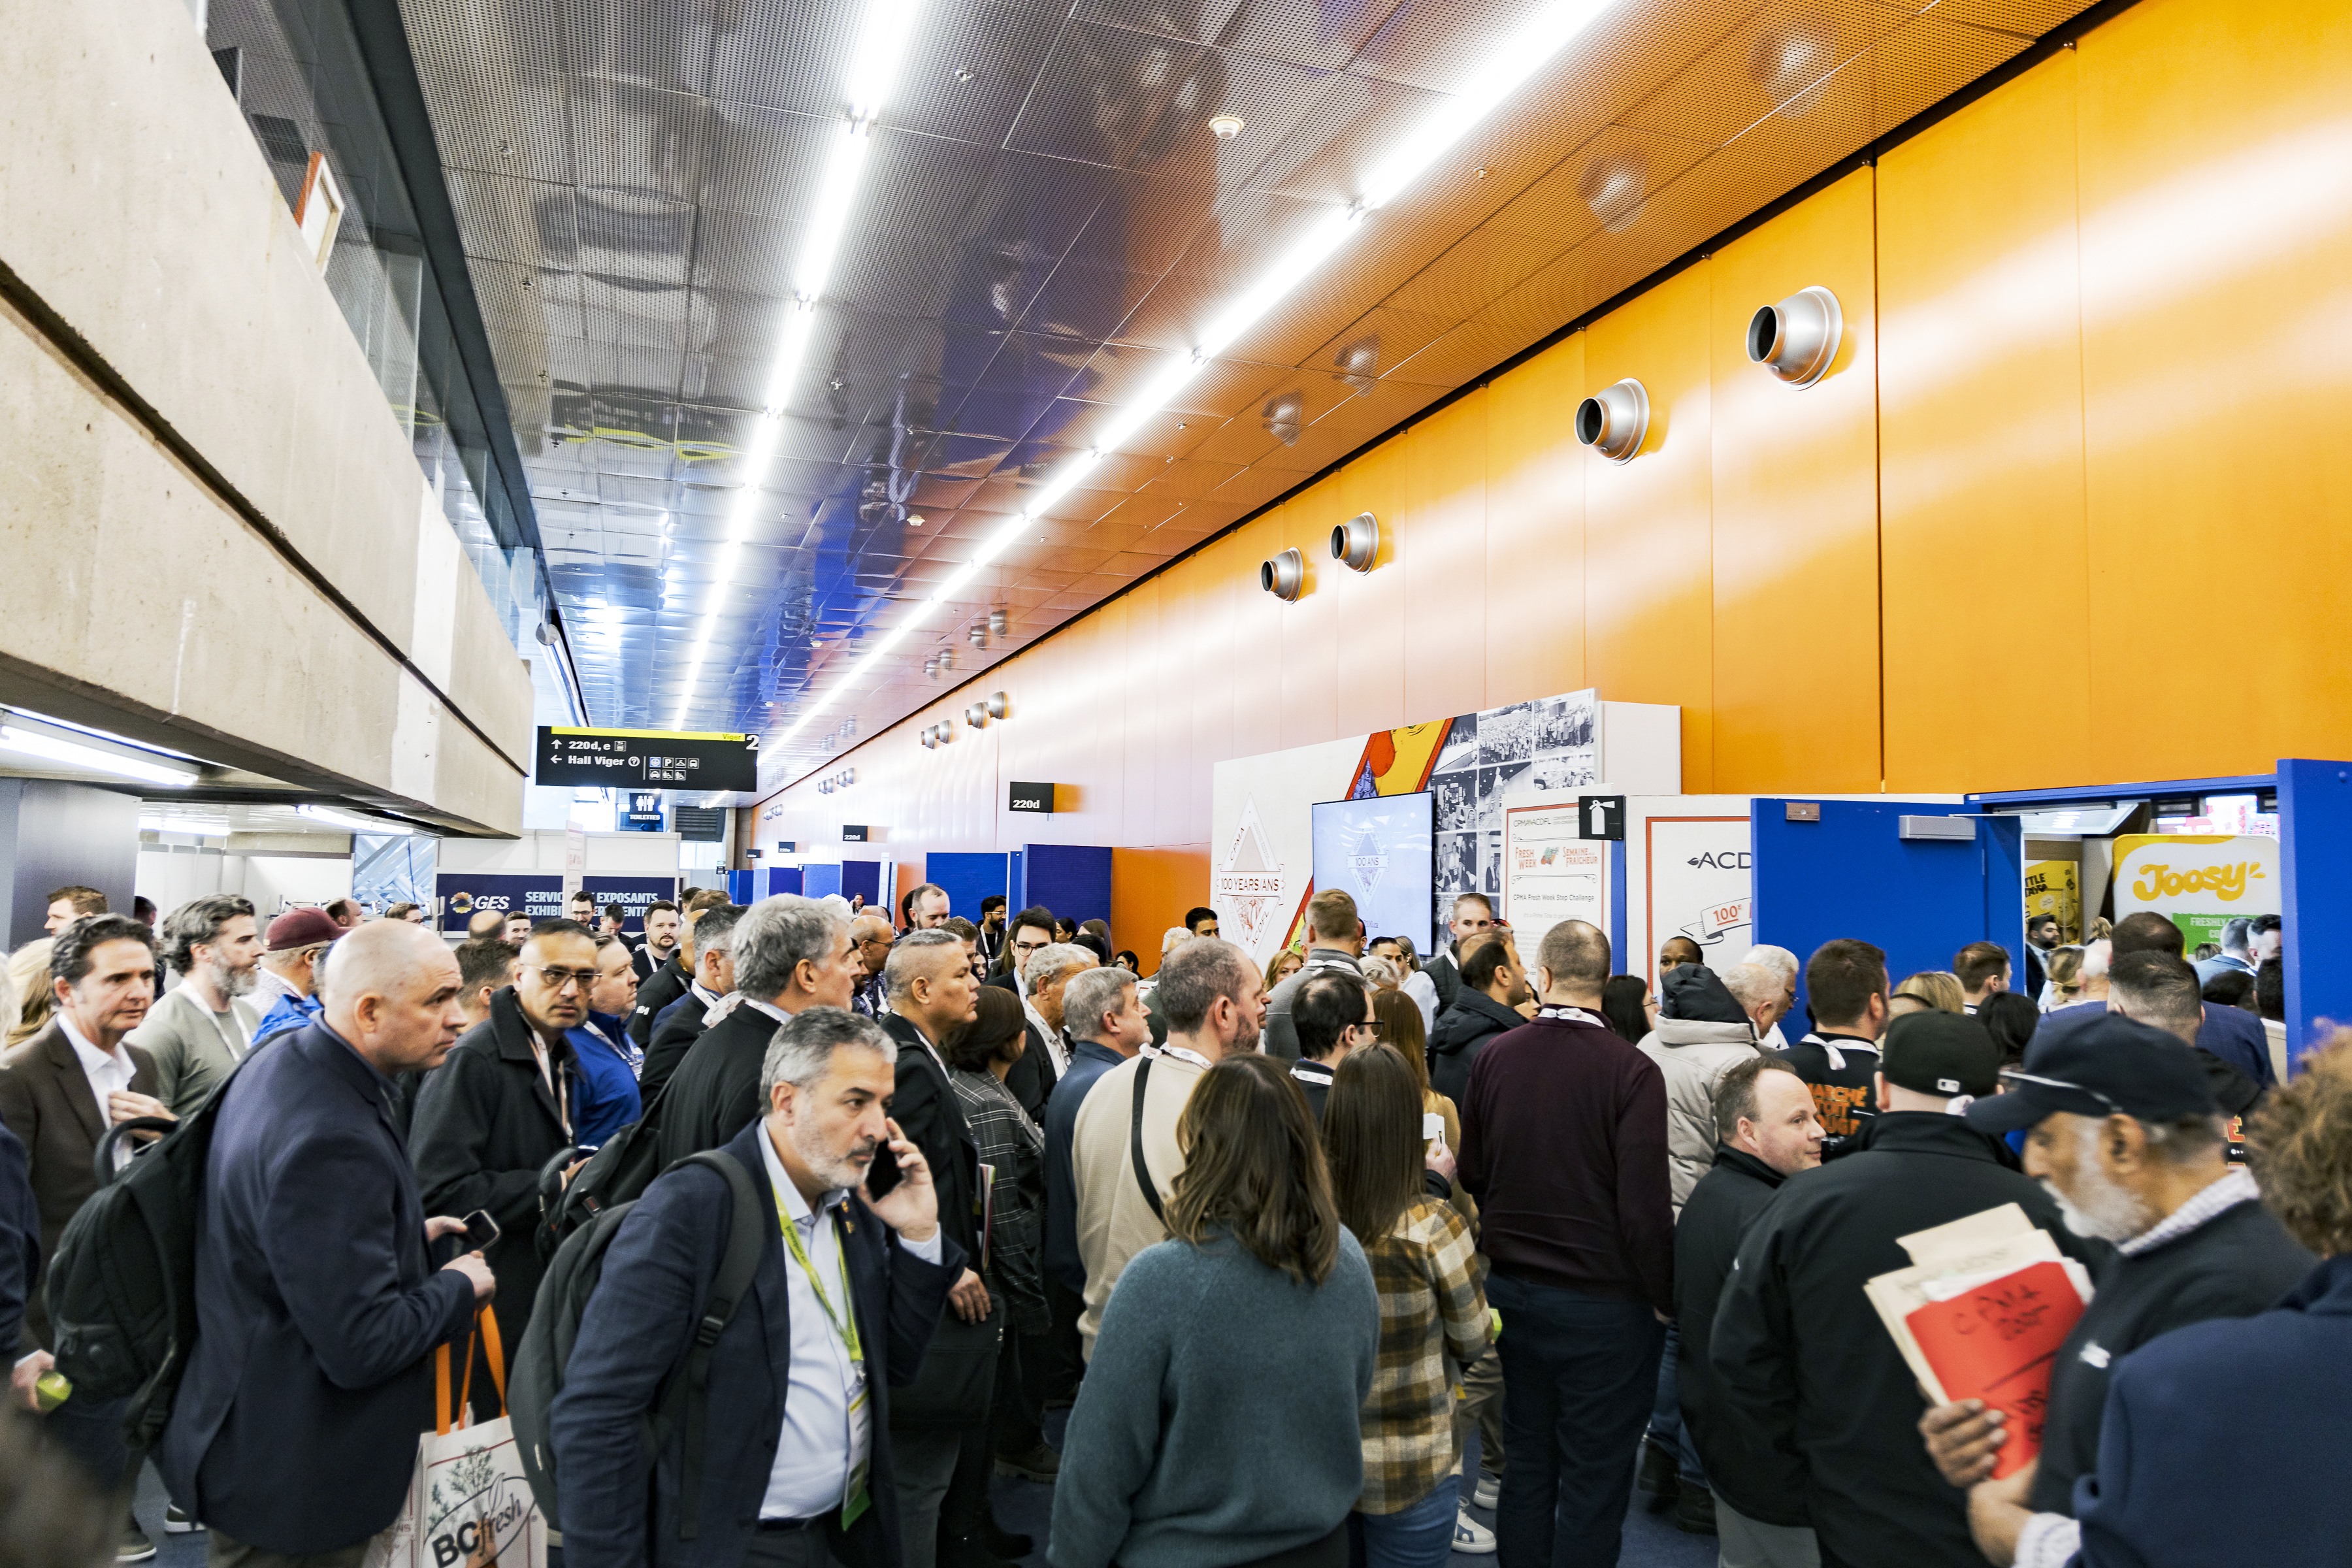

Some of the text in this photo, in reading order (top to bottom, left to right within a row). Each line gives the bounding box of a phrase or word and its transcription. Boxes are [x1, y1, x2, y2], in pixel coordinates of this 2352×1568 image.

[568, 741, 602, 751] 220d,
[746, 734, 760, 750] 2
[568, 755, 625, 768] Hall Viger
[1013, 799, 1040, 809] 220d
[1515, 847, 1535, 860] FRESH
[1562, 846, 1588, 857] SEMAINE
[1355, 857, 1379, 866] 100 ANS
[1518, 858, 1537, 870] WEEK
[1697, 851, 1752, 870] ACD
[1221, 877, 1233, 890] 100
[2025, 872, 2046, 887] TTLE
[2132, 860, 2247, 902] Joosy
[474, 896, 510, 910] GES
[525, 891, 658, 904] SERVIC EXPOSANTS
[1569, 894, 1594, 902] Challenge
[525, 905, 563, 916] EXHIBI
[2190, 917, 2227, 926] FRESHLY
[1816, 1114, 1861, 1135] OUGE
